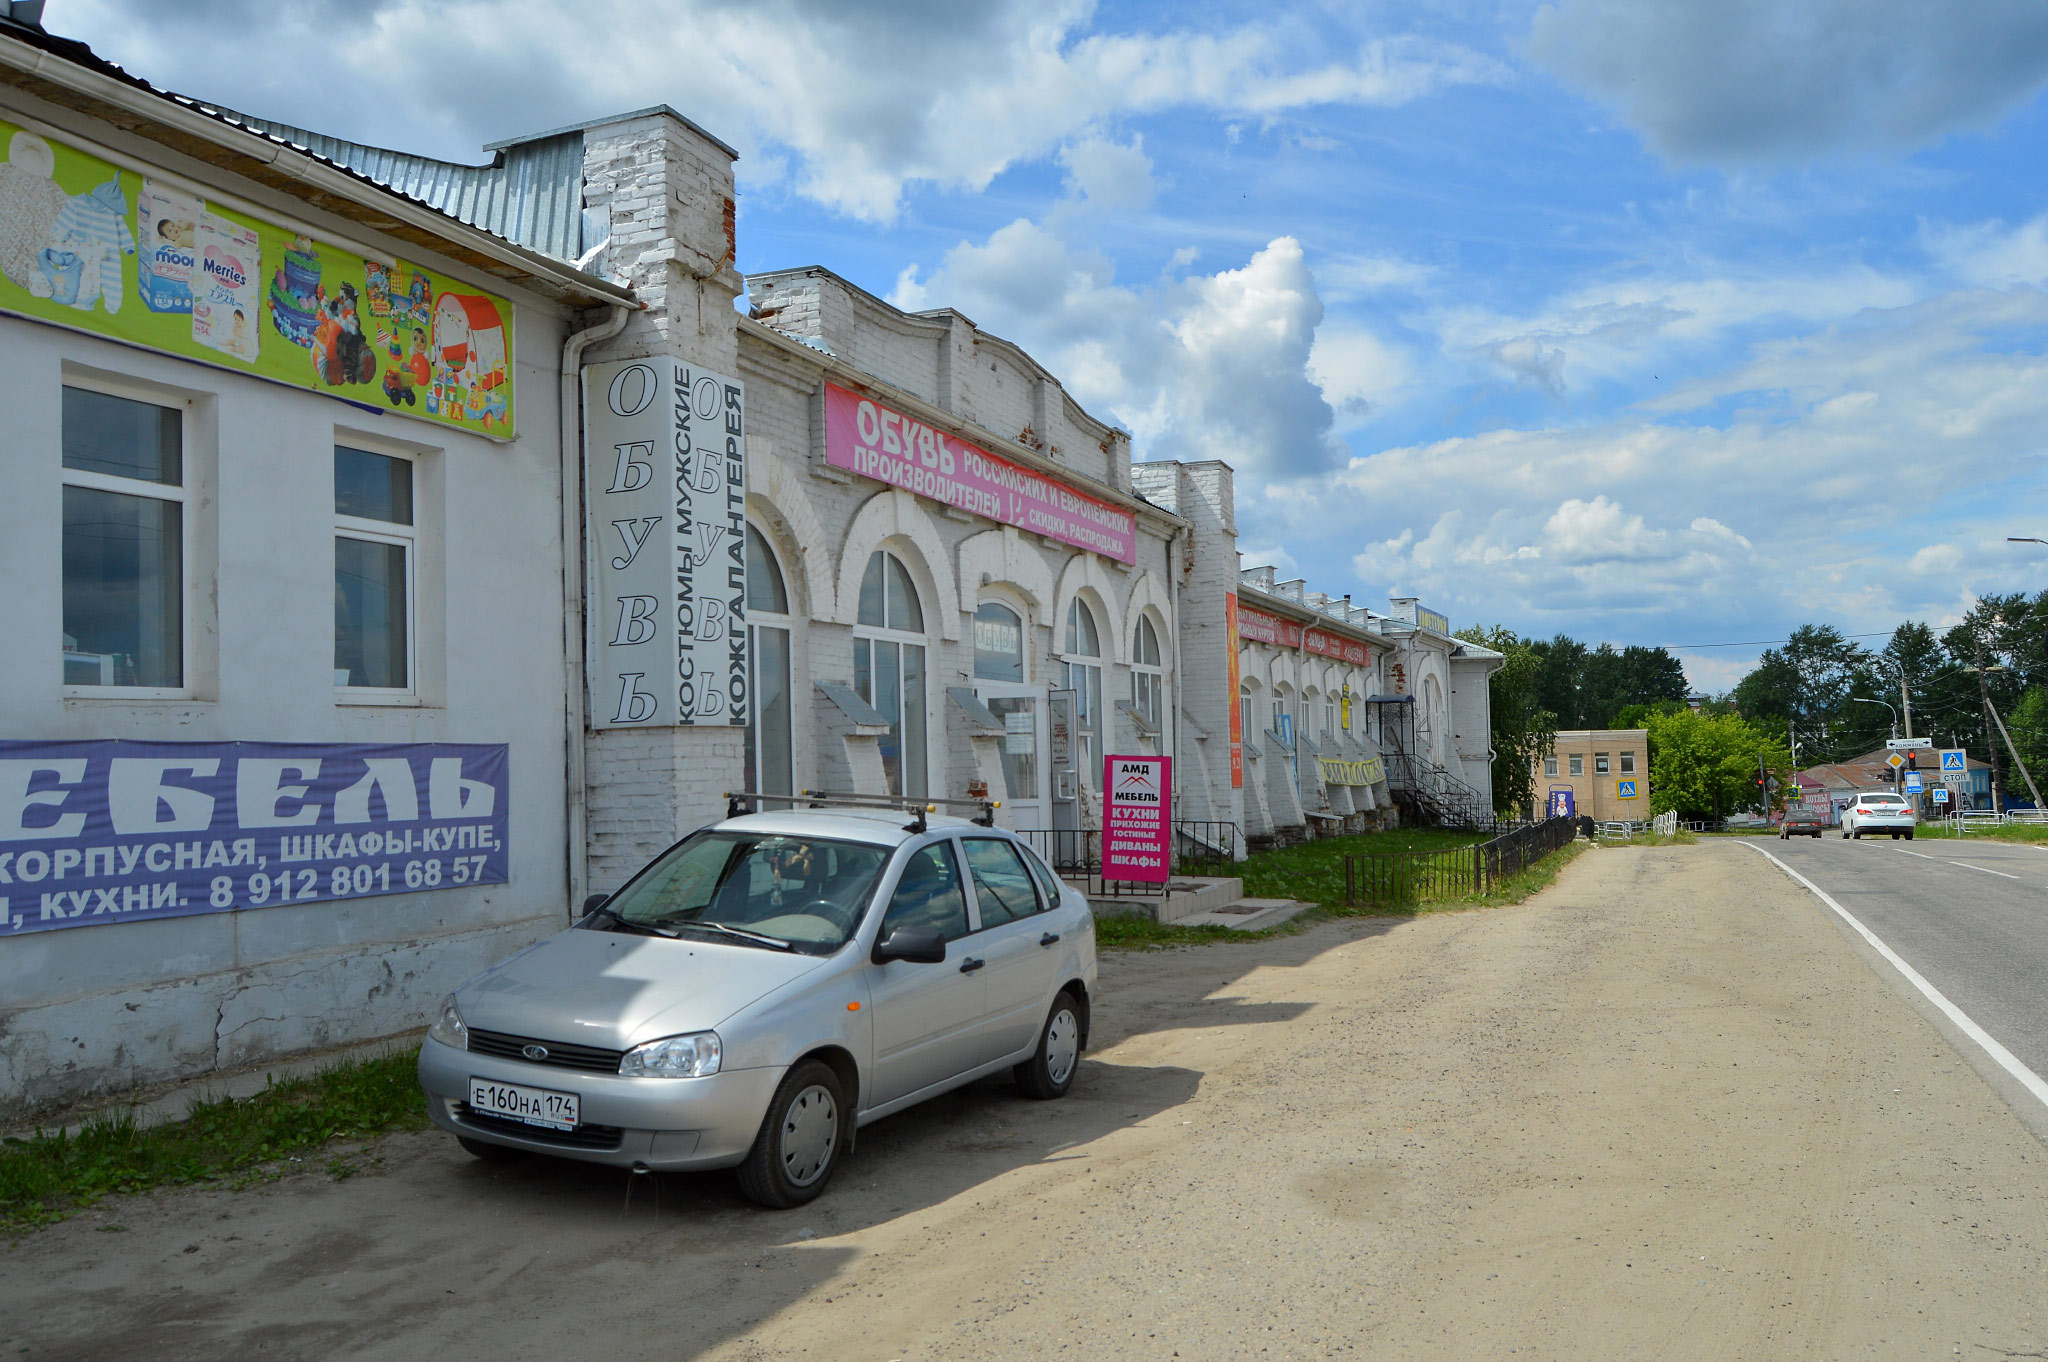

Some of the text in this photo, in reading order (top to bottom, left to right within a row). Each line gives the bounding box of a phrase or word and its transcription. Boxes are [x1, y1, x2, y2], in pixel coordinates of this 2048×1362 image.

[204, 258, 246, 285] Merries
[857, 400, 1130, 535] ОБУВЬ РОССИЙСКИХ И ЕВРОПЕЙСКИХ
[854, 446, 1125, 556] ПРОИЗВОДИТЕЛЕЙ СКИДКИ, РАСПРОДАЖА
[606, 364, 662, 723] ОБУВЬ
[674, 365, 695, 725] КОСТЮМЫ МУЖСКИЕ
[691, 376, 726, 717] ОБУВЬ
[724, 384, 746, 725] КОЖГАЛАНТЕРЕЯ
[976, 624, 1017, 650] ОБУВЬ
[1121, 764, 1149, 775] АМД
[1944, 774, 1967, 782] СТОП
[1114, 792, 1158, 802] МЕБЕЛЬ
[1110, 820, 1160, 830] ПРИХОЖИЕ
[1112, 808, 1160, 820] КУХНИ
[280, 824, 502, 863] ШКАФЫ-КУПЕ,
[1110, 841, 1161, 852] ДИВАНЫ
[1113, 830, 1156, 839] ГОСТИНЫЕ
[1111, 854, 1161, 868] ШКАФЫ
[40, 883, 188, 921] КУХНИ.
[210, 875, 234, 909] 8
[248, 868, 318, 906] 912
[331, 862, 391, 896] 801
[404, 857, 443, 890] 68
[452, 854, 488, 884] 57
[545, 1095, 572, 1115] 174
